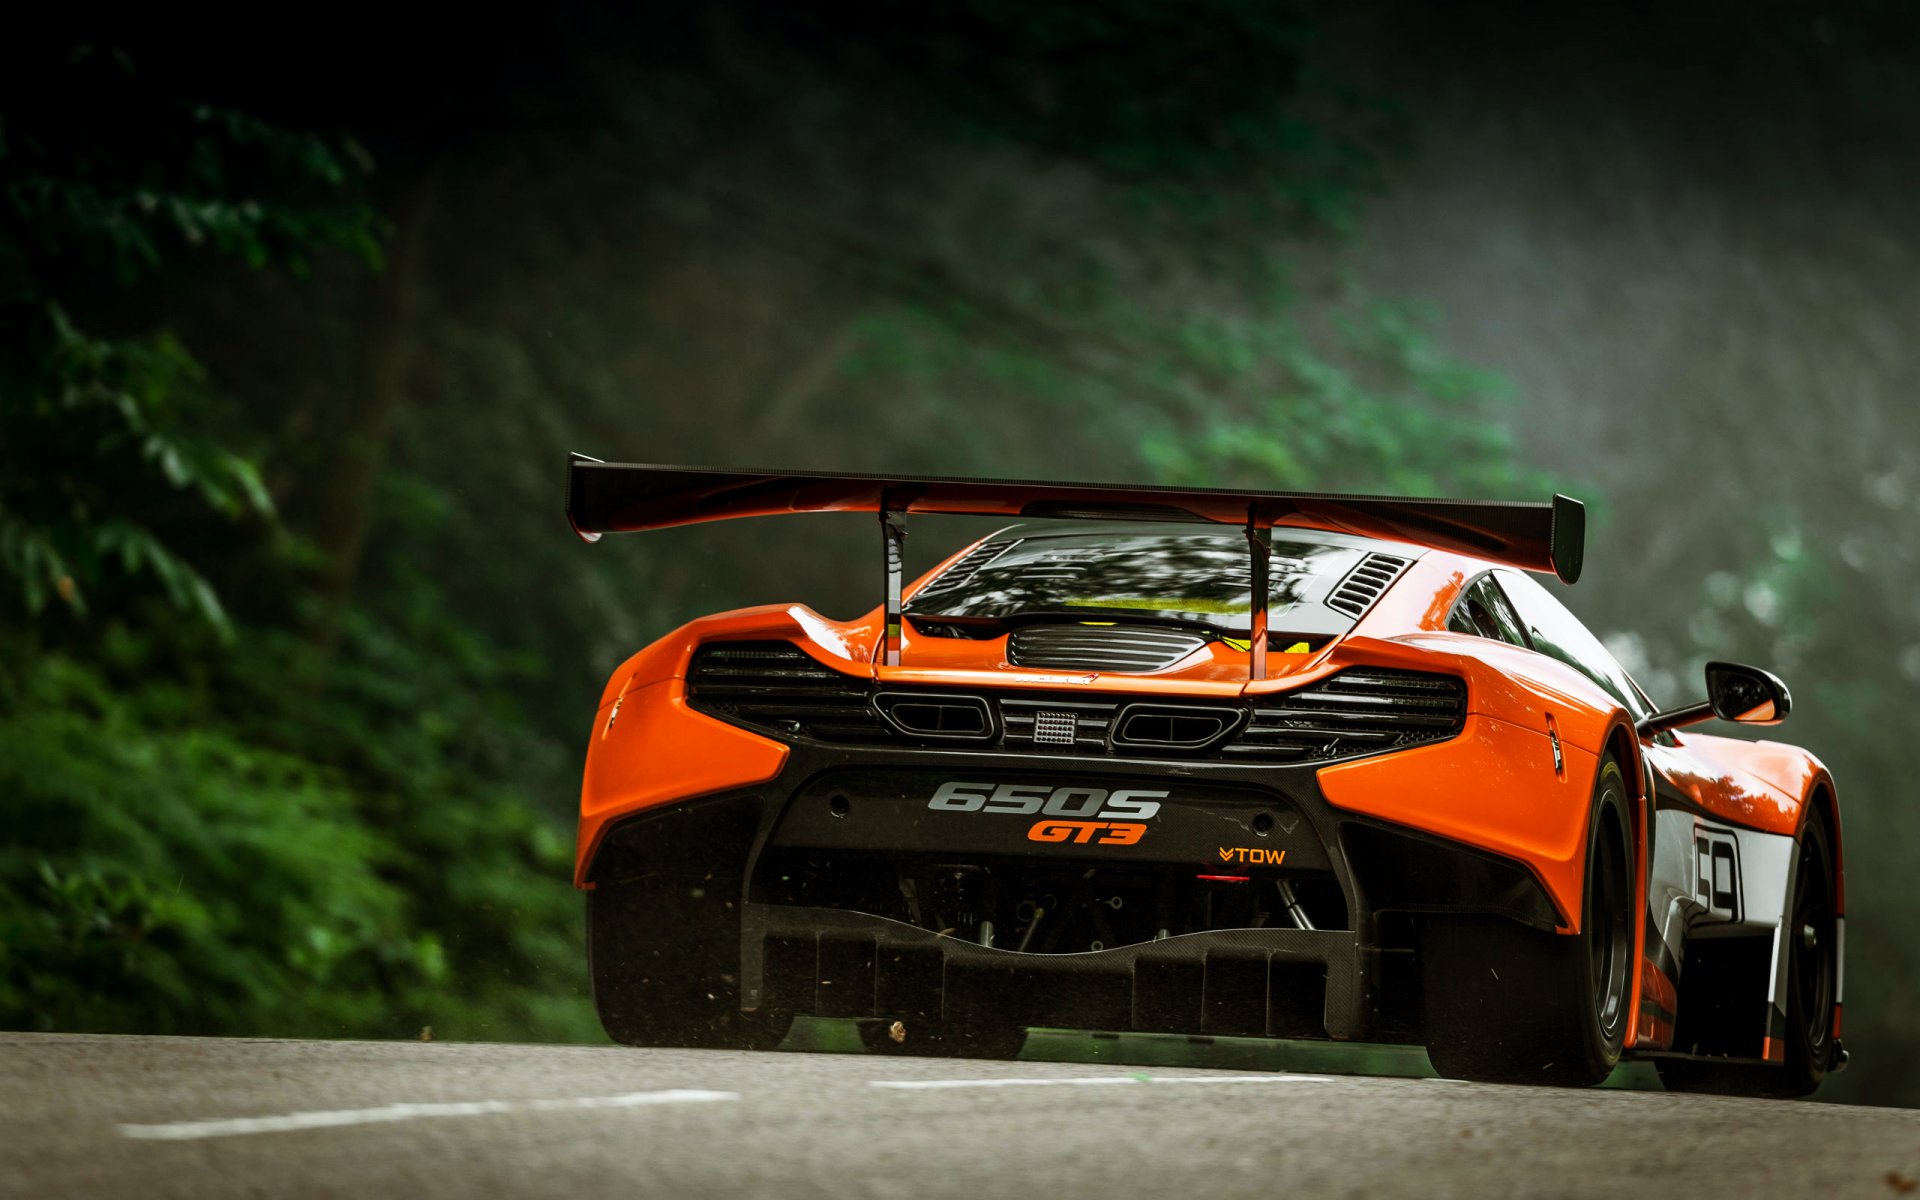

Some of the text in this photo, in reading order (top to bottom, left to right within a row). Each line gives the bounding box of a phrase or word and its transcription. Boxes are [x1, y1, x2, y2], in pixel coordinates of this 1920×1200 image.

[927, 782, 1170, 819] 650S
[1027, 820, 1147, 845] GT3
[1235, 848, 1286, 865] TOW
